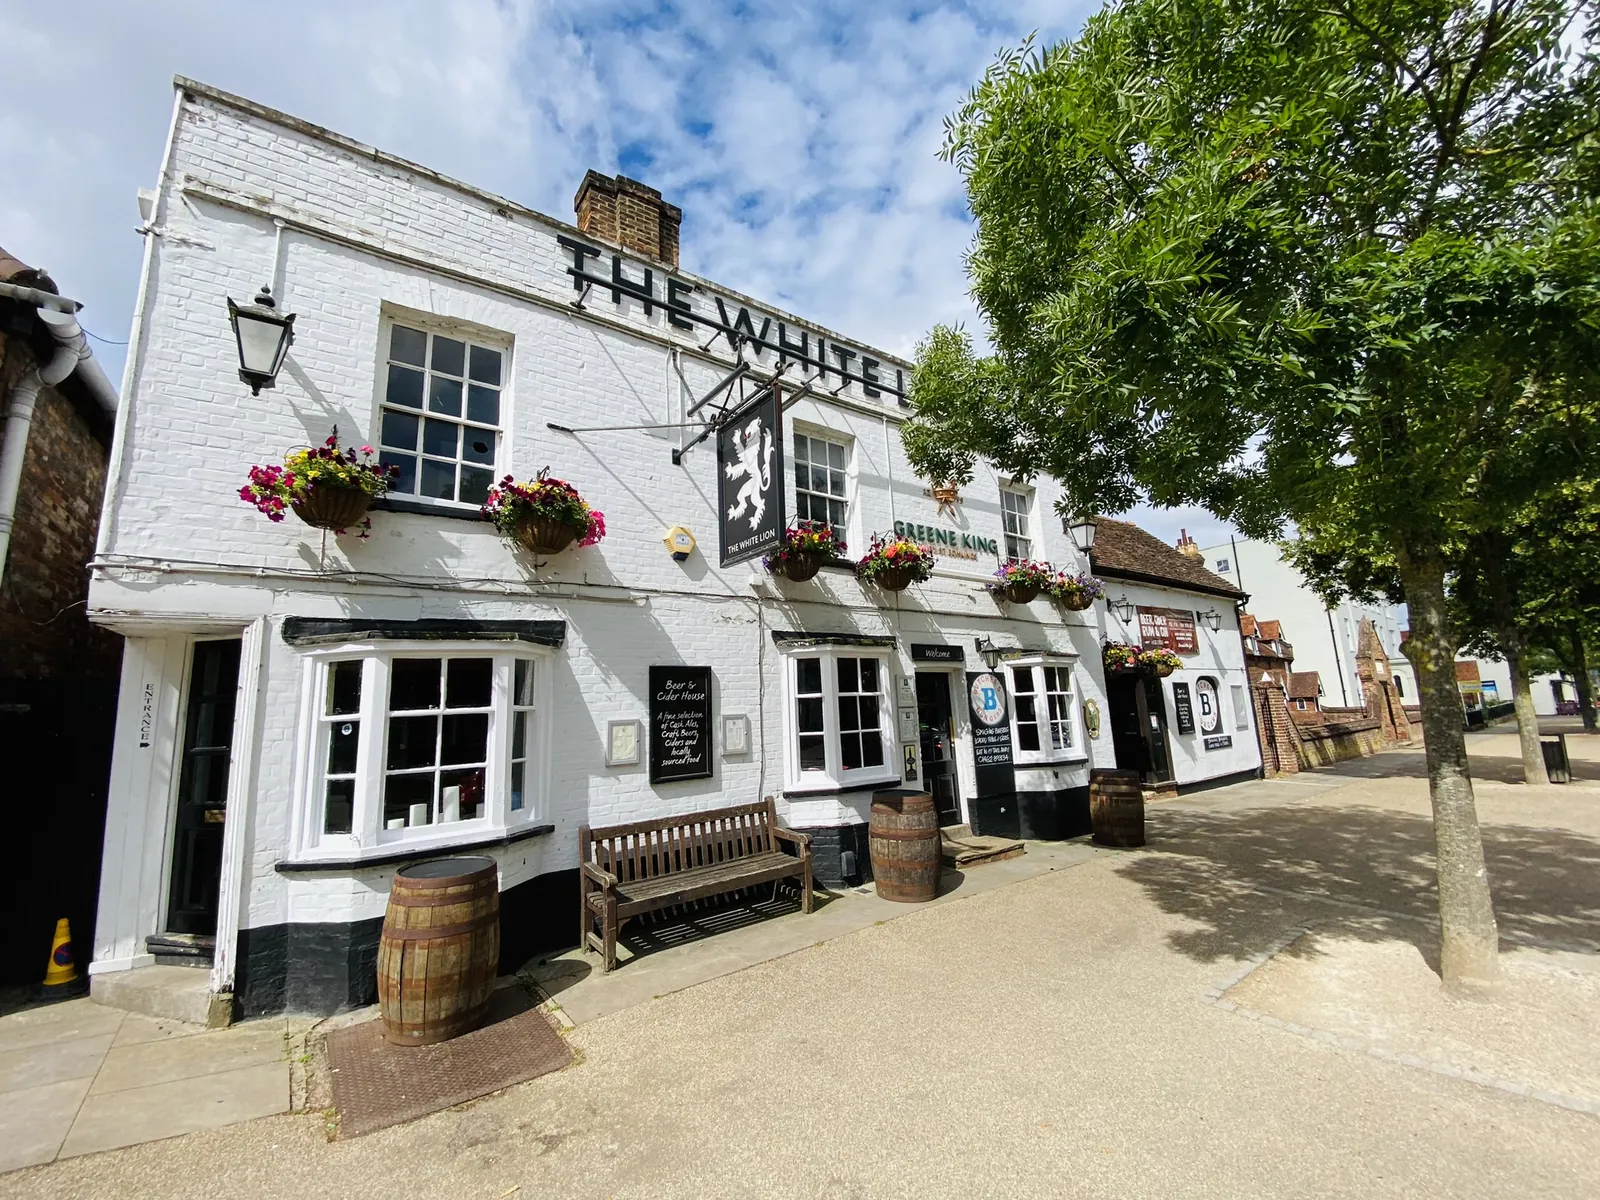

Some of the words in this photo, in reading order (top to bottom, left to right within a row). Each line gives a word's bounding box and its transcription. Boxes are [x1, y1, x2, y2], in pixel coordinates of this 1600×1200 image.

[557, 234, 694, 331] THE
[715, 296, 881, 398] WHITE
[728, 542, 740, 554] THE
[739, 534, 758, 550] WHITE
[759, 528, 776, 542] LION
[894, 520, 957, 546] GREENE
[962, 533, 998, 554] KING
[925, 648, 951, 658] Welcome
[665, 680, 686, 690] Beer
[688, 680, 696, 690] &
[656, 690, 680, 701] Cider
[680, 690, 705, 700] House
[981, 688, 997, 710] B
[1199, 693, 1211, 716] B
[140, 684, 154, 740] ENTRANCE
[656, 712, 663, 720] A
[663, 711, 676, 722] fine
[677, 711, 704, 720] selection
[661, 720, 669, 730] of
[669, 720, 684, 728] Cask
[685, 719, 699, 728] Ales,
[661, 729, 680, 738] Craft
[680, 729, 699, 738] Beers,
[664, 738, 684, 747] Ciders
[661, 756, 686, 766] sourced
[686, 753, 702, 764] food
